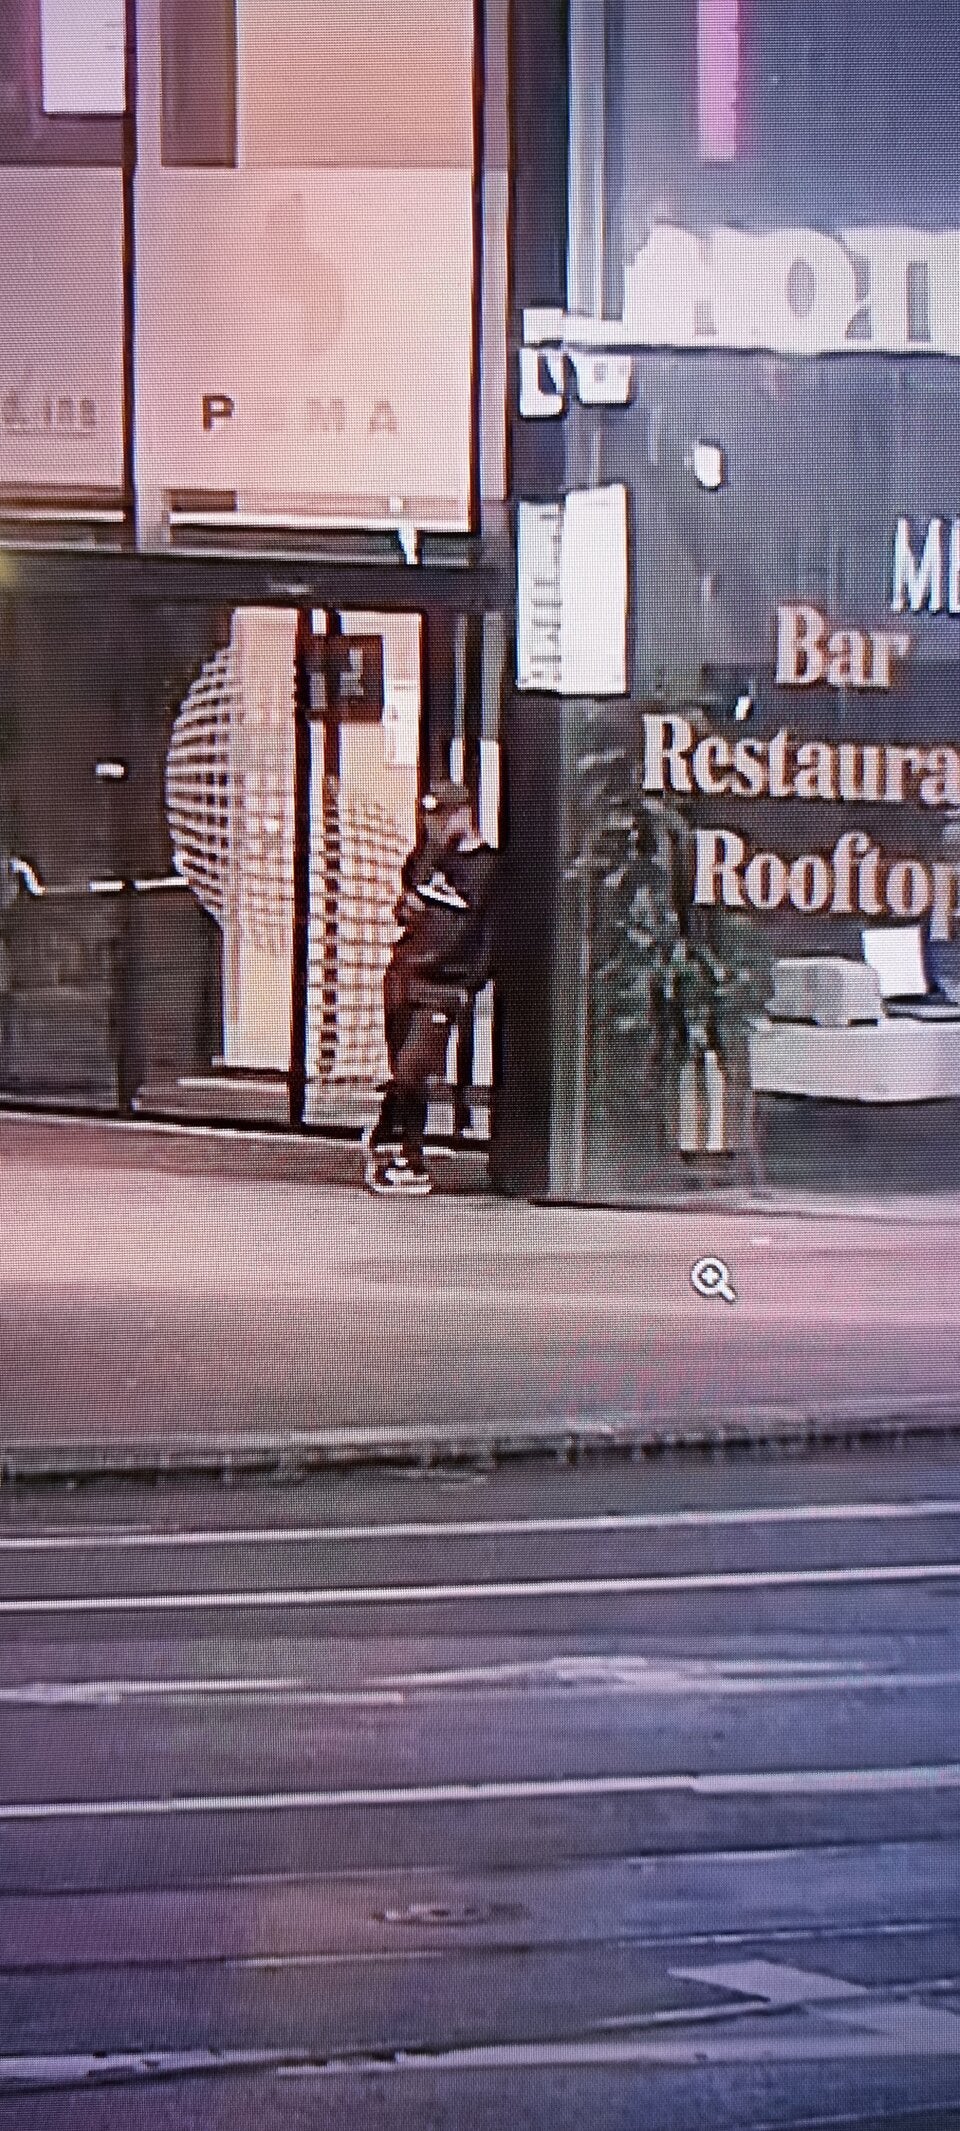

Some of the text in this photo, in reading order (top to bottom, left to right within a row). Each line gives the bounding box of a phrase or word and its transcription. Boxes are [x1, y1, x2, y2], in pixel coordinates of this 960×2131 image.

[201, 394, 399, 433] PMA
[776, 605, 911, 687] Bar
[642, 714, 960, 805] Restaura
